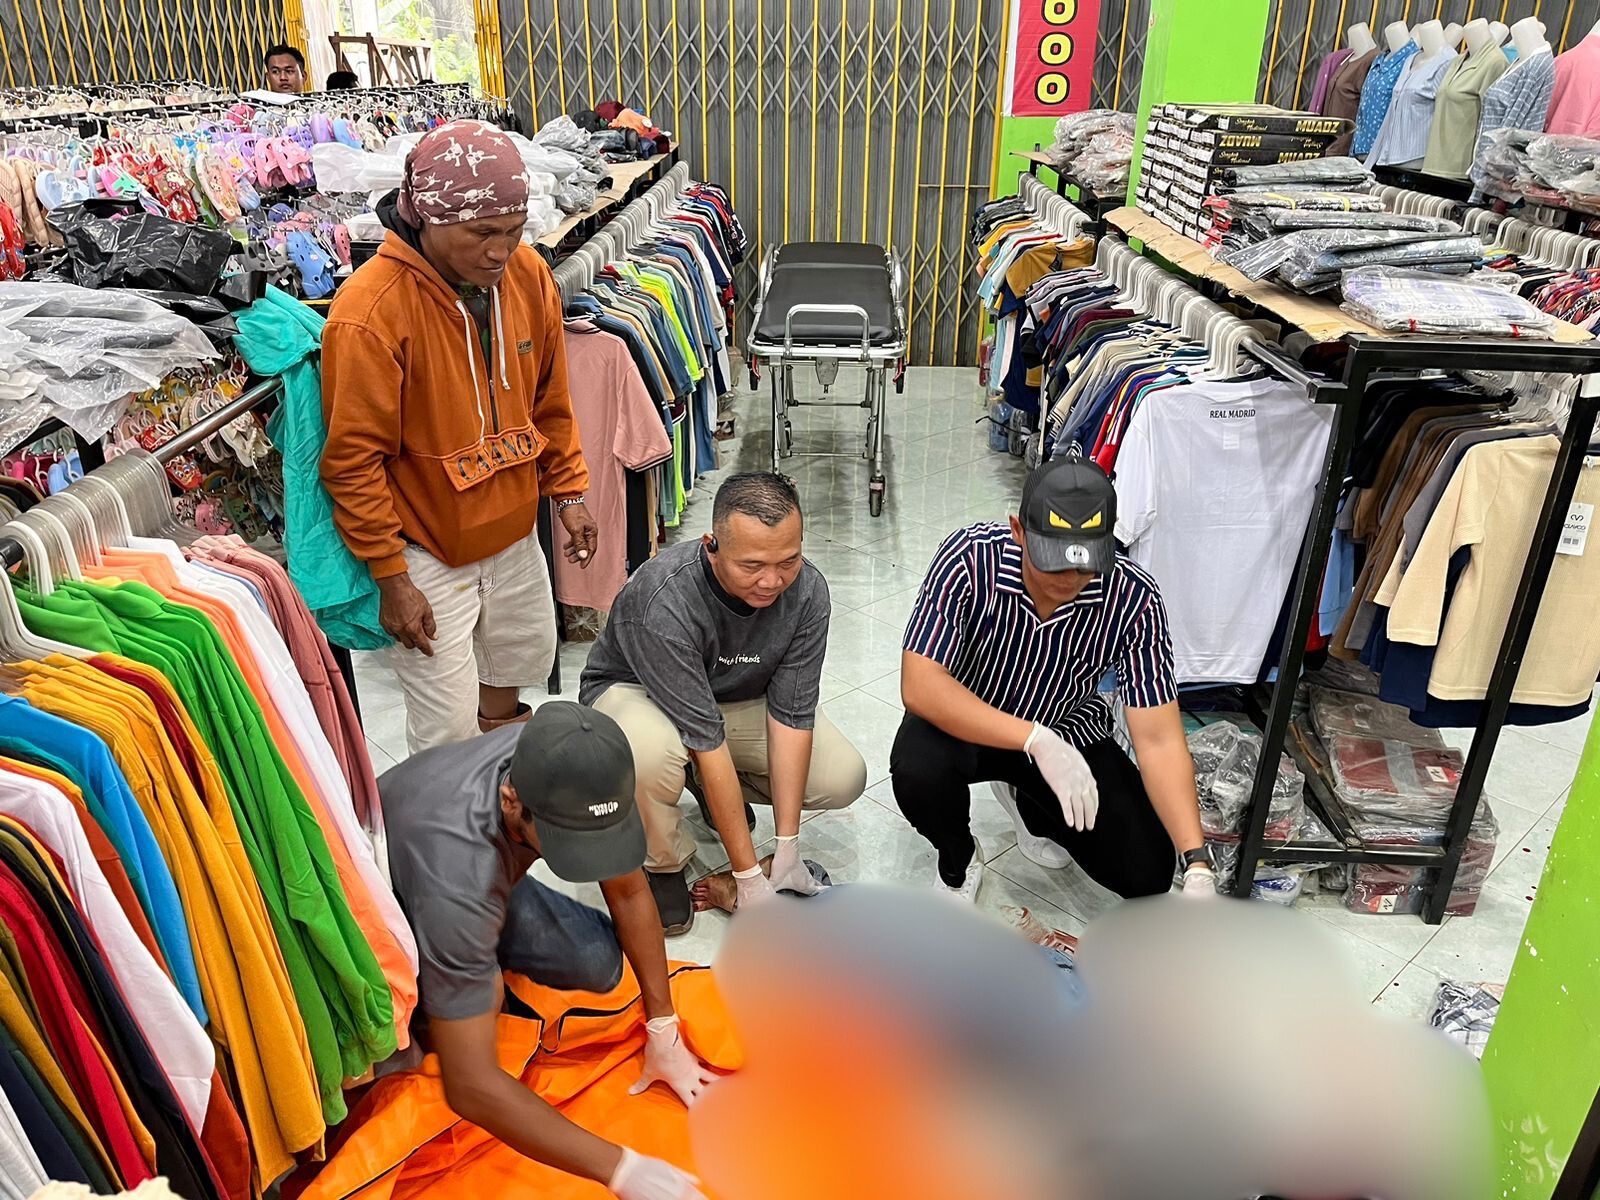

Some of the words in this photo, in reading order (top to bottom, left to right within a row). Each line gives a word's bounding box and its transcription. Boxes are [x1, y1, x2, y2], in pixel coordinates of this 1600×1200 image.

[1295, 120, 1340, 133] MUADZ
[1219, 135, 1262, 147] MUADZ
[1209, 410, 1227, 419] REAL
[1228, 409, 1256, 419] MADRID
[734, 653, 761, 665] friends
